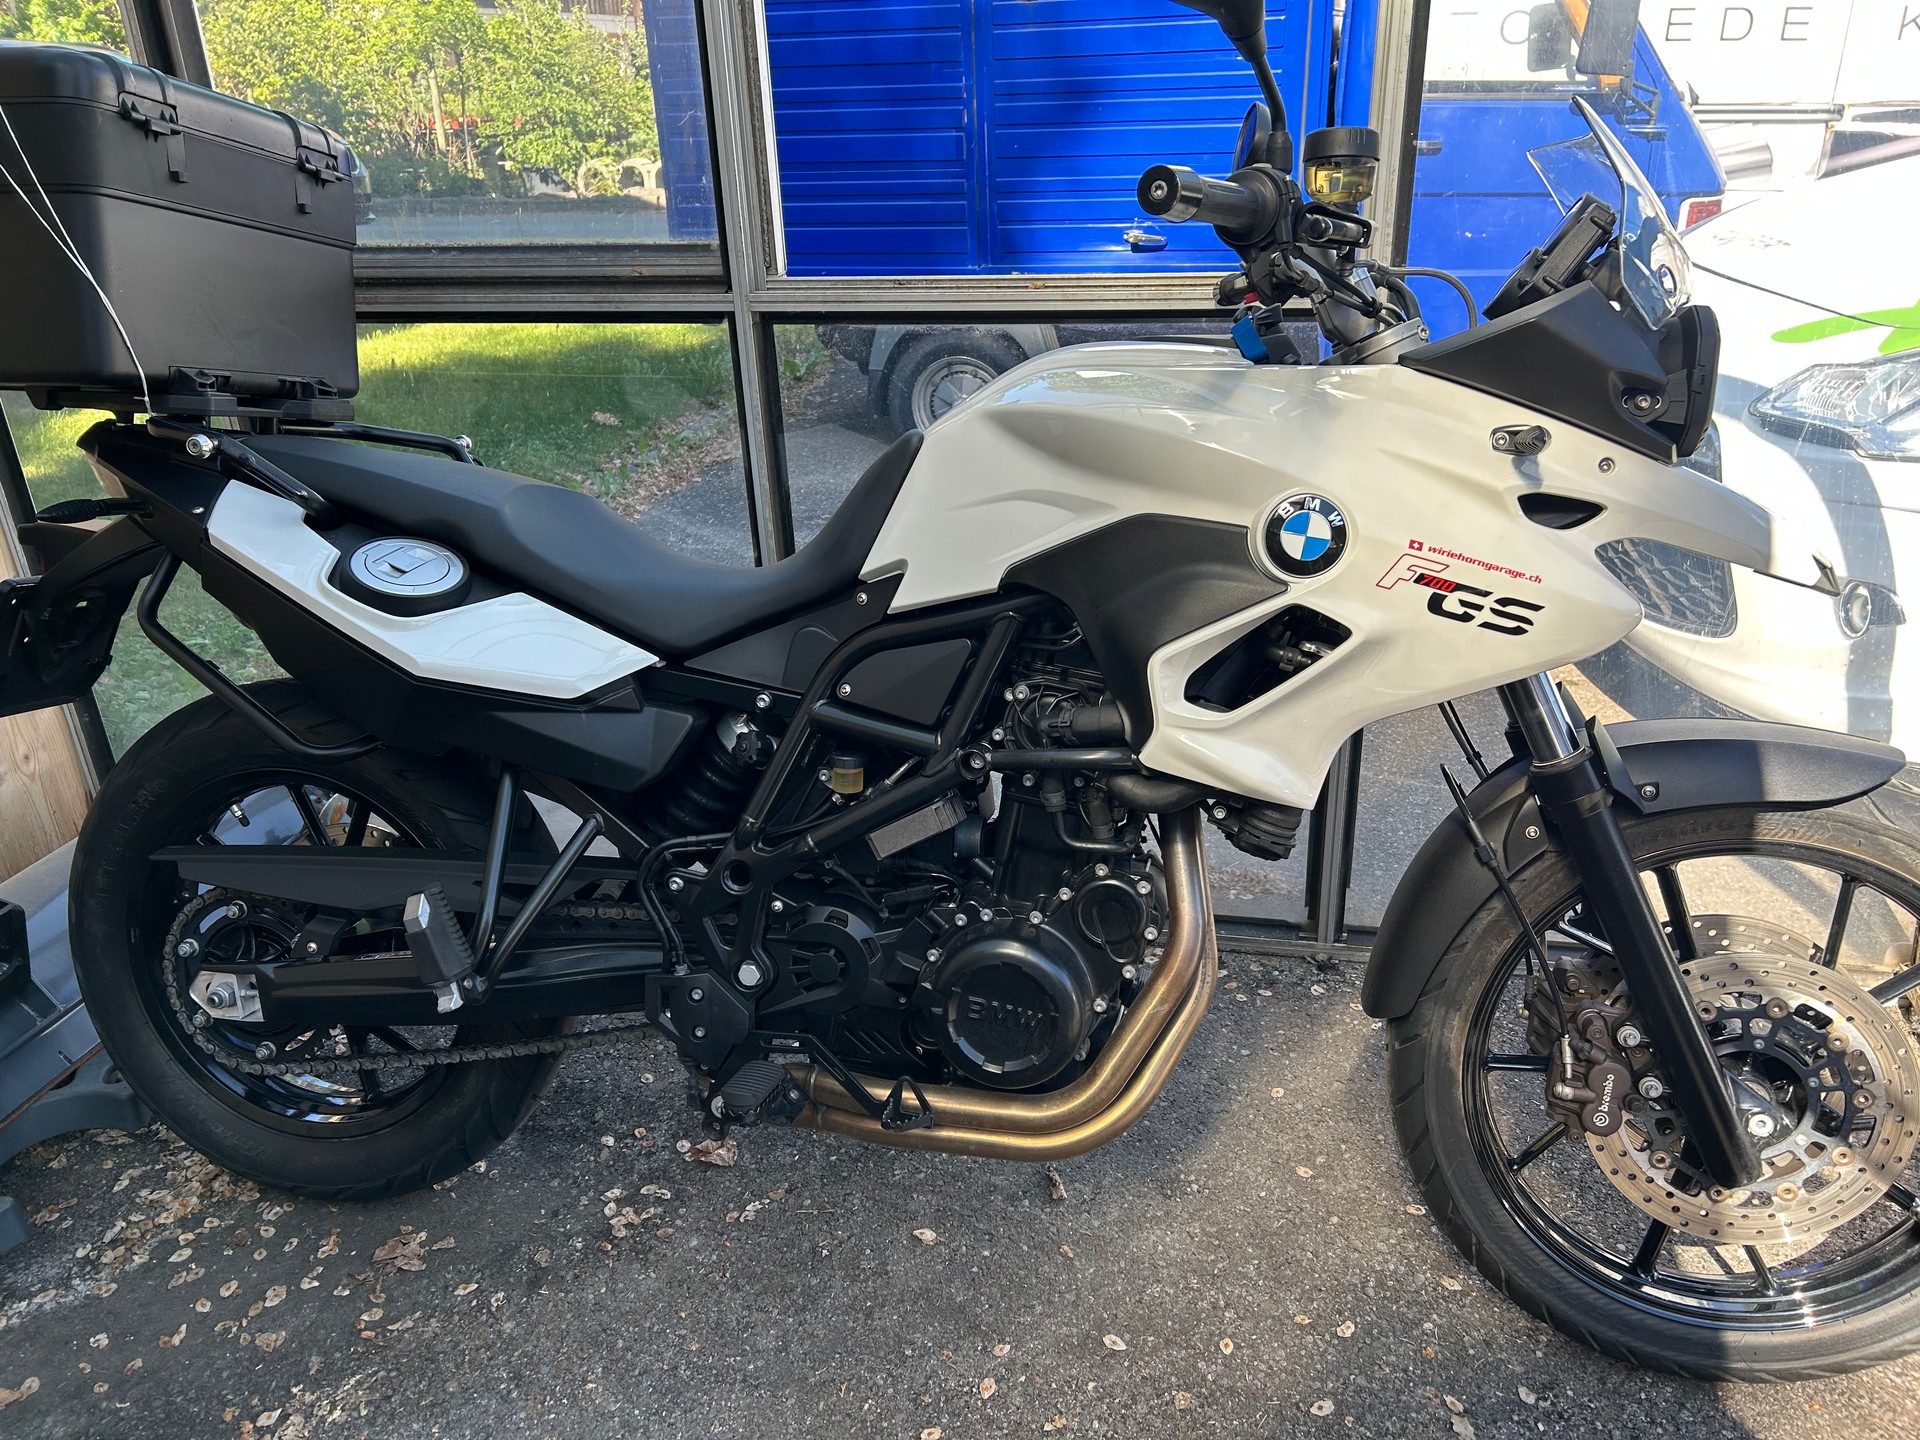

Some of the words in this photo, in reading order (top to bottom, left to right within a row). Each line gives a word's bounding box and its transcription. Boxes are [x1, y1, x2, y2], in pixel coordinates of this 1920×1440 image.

[1278, 497, 1344, 527] BMW
[1420, 574, 1457, 592] 700
[1428, 546, 1542, 584] wiriehorngarage.ch
[1427, 590, 1546, 636] GS
[967, 995, 1043, 1031] BMW
[1598, 1074, 1615, 1111] brembo
